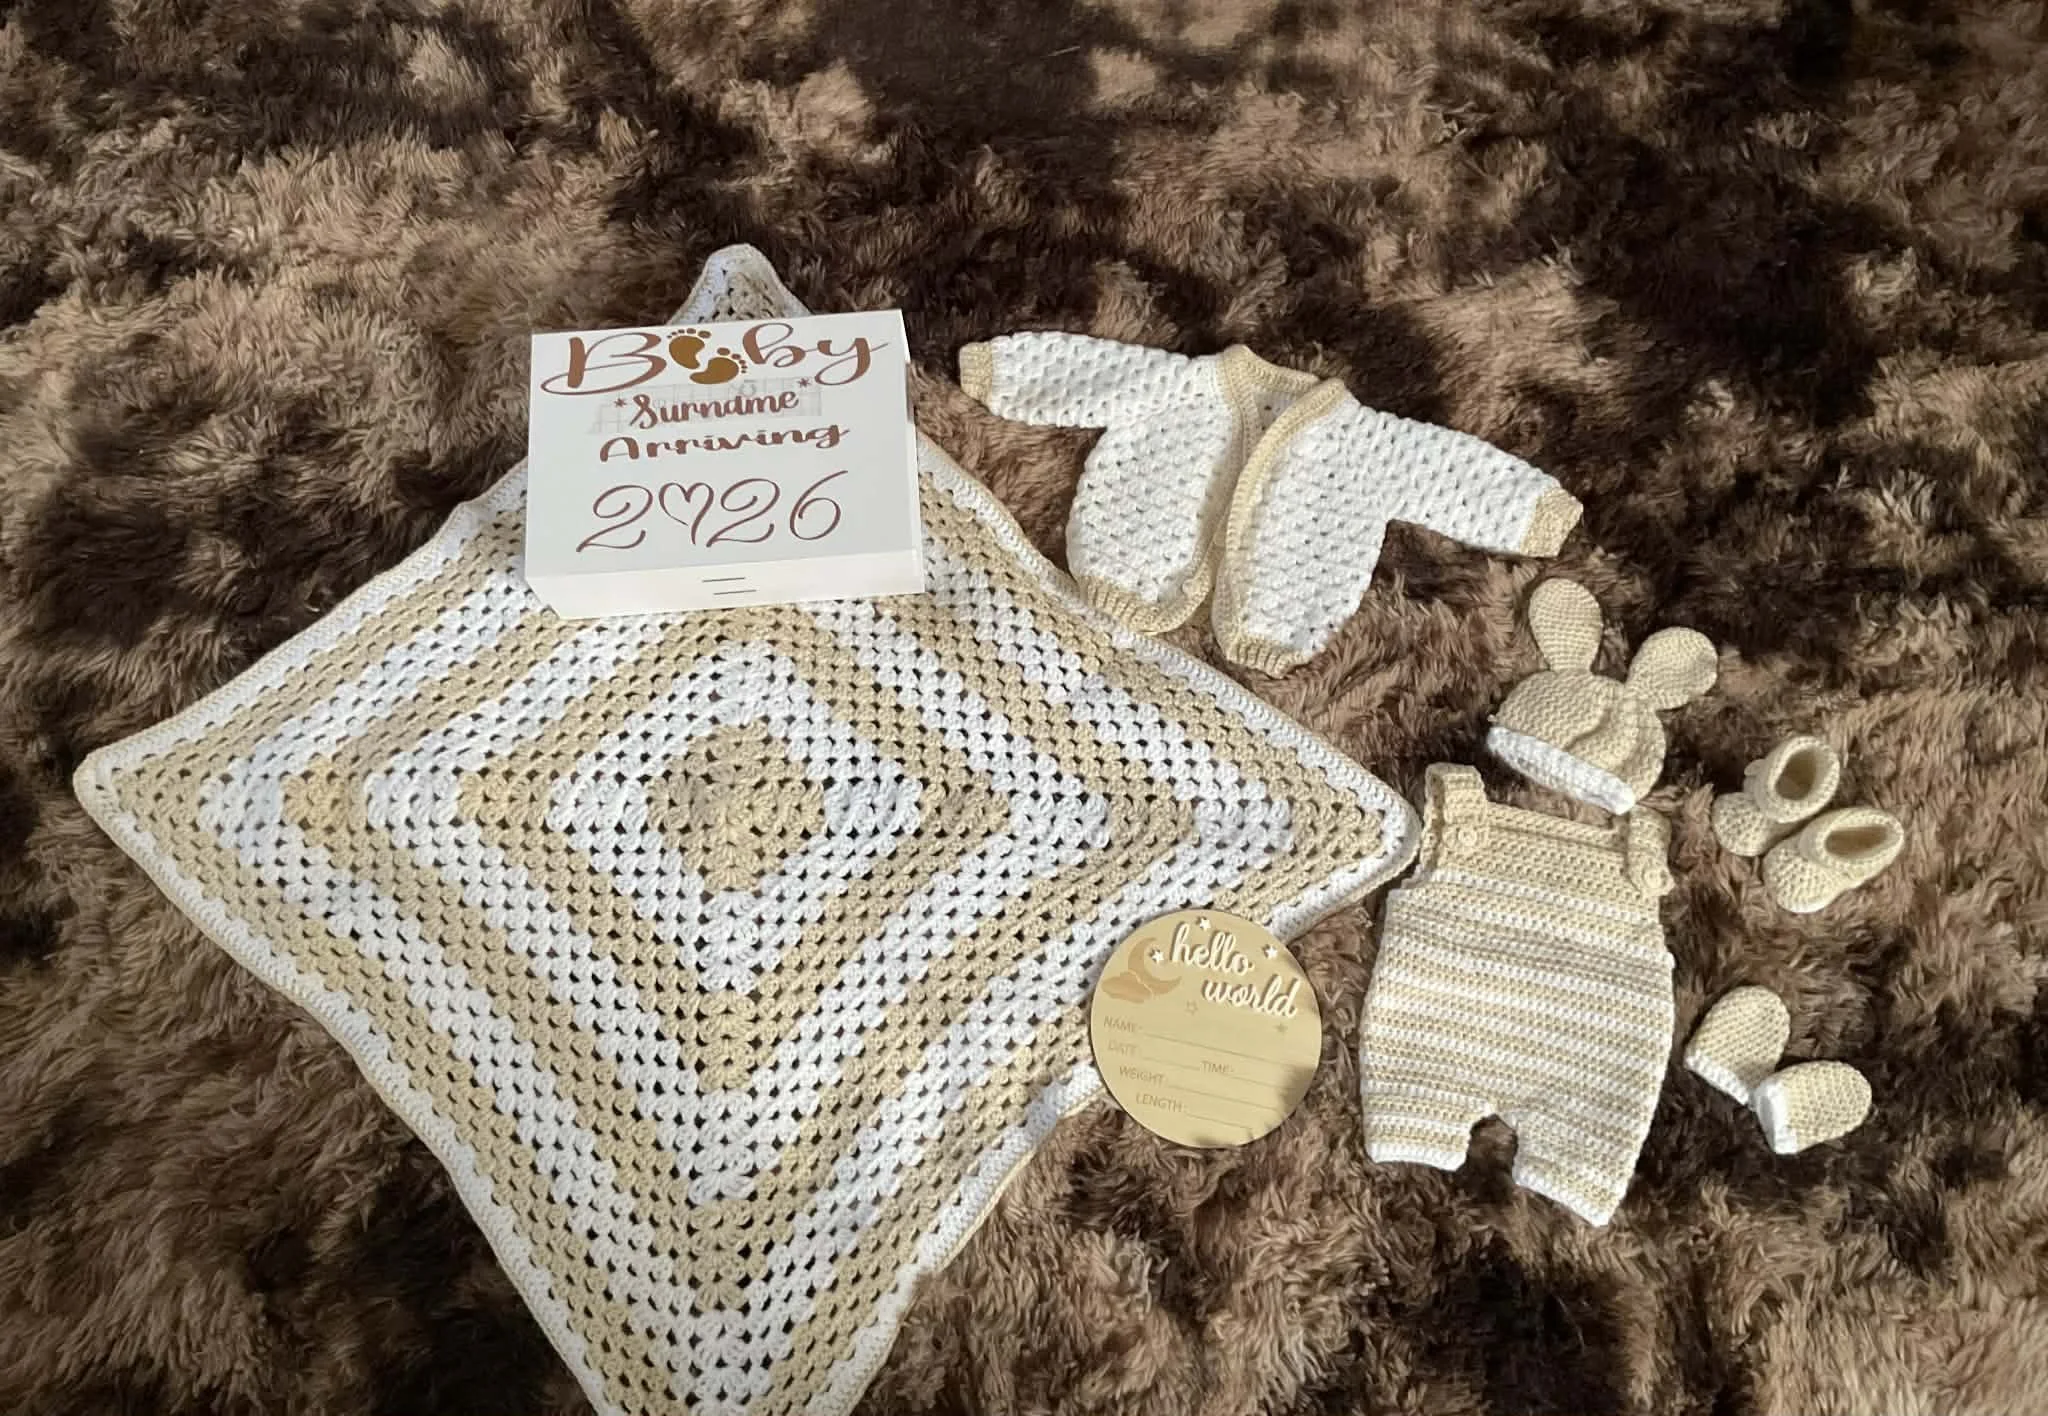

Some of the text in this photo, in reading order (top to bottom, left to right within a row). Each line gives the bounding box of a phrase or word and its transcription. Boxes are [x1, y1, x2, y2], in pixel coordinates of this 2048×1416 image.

[540, 322, 889, 396] Bby
[599, 424, 851, 463] Arriving
[1169, 921, 1255, 976] hello
[1201, 973, 1301, 1019] world
